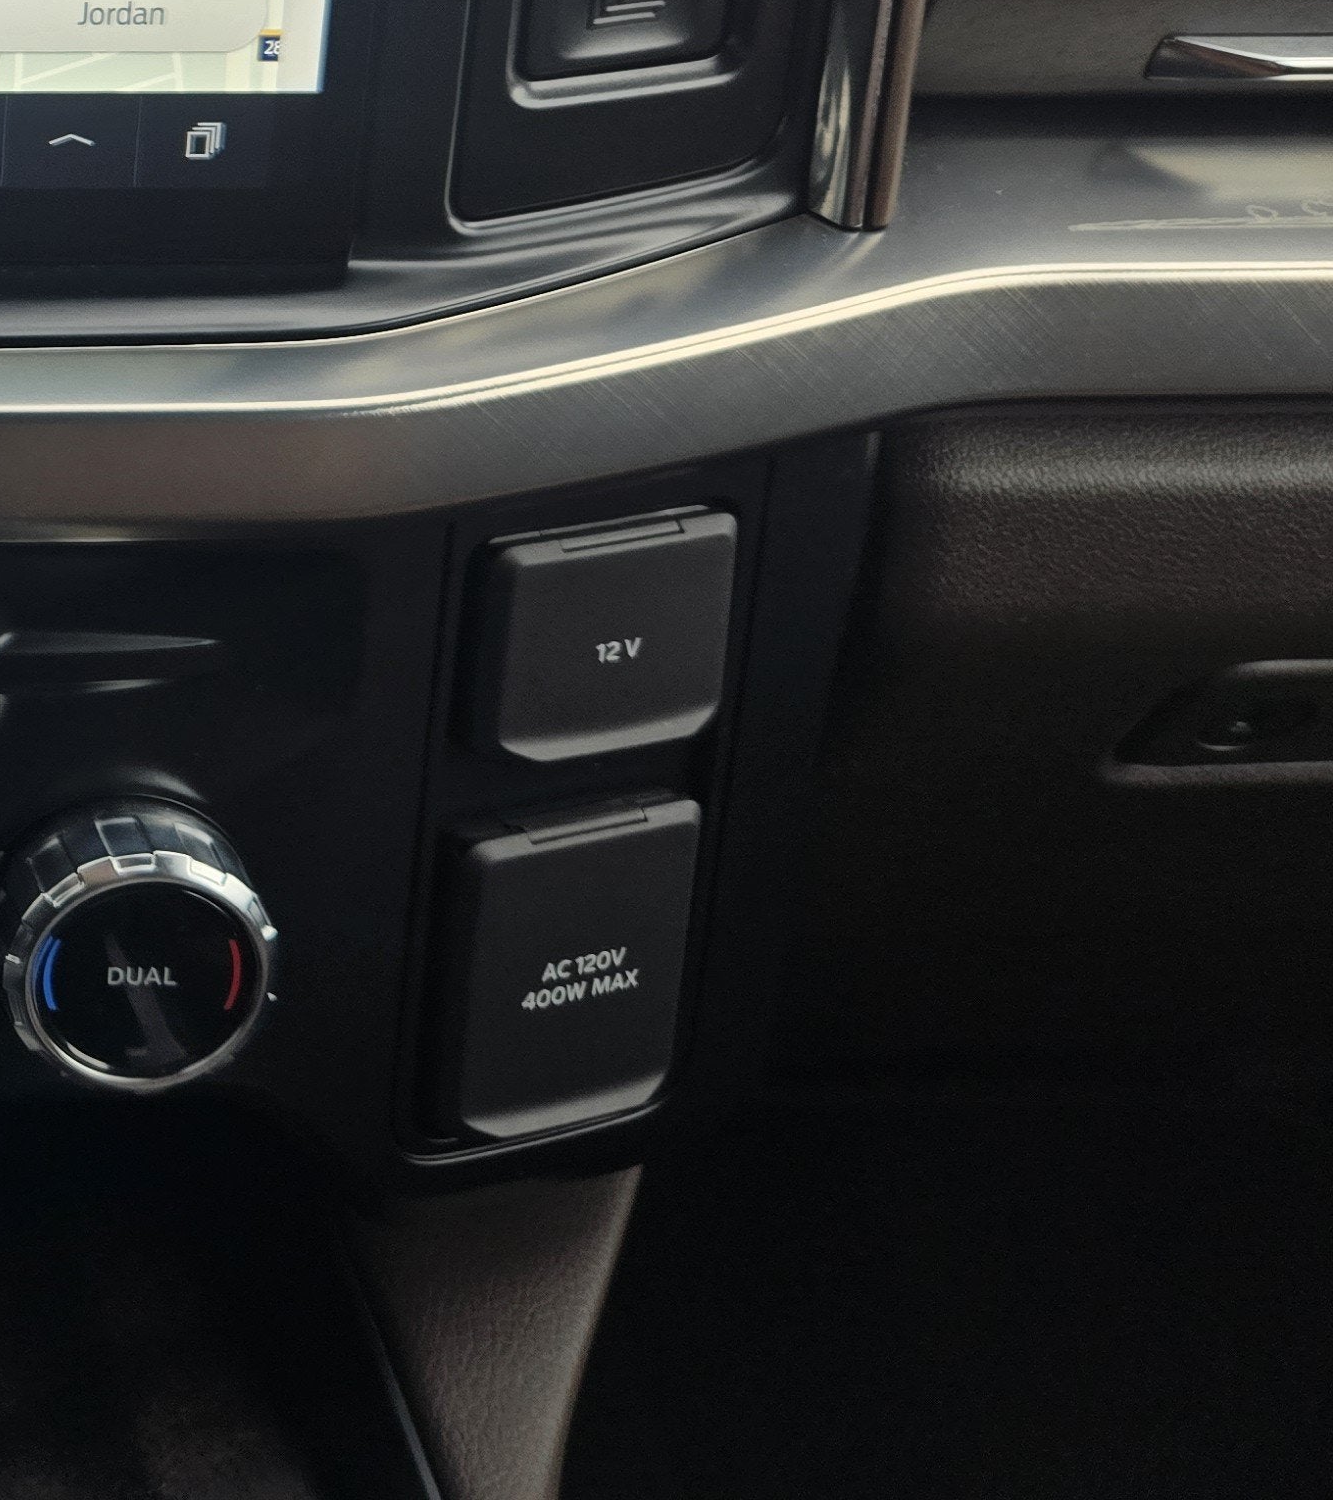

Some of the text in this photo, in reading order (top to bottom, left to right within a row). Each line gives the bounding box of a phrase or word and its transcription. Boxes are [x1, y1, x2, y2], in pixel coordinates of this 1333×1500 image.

[78, 1, 164, 25] Jordan
[596, 637, 642, 662] 12 V
[108, 967, 176, 986] DUAL
[541, 946, 627, 982] AC 120V
[521, 968, 639, 1011] 400W MAX
